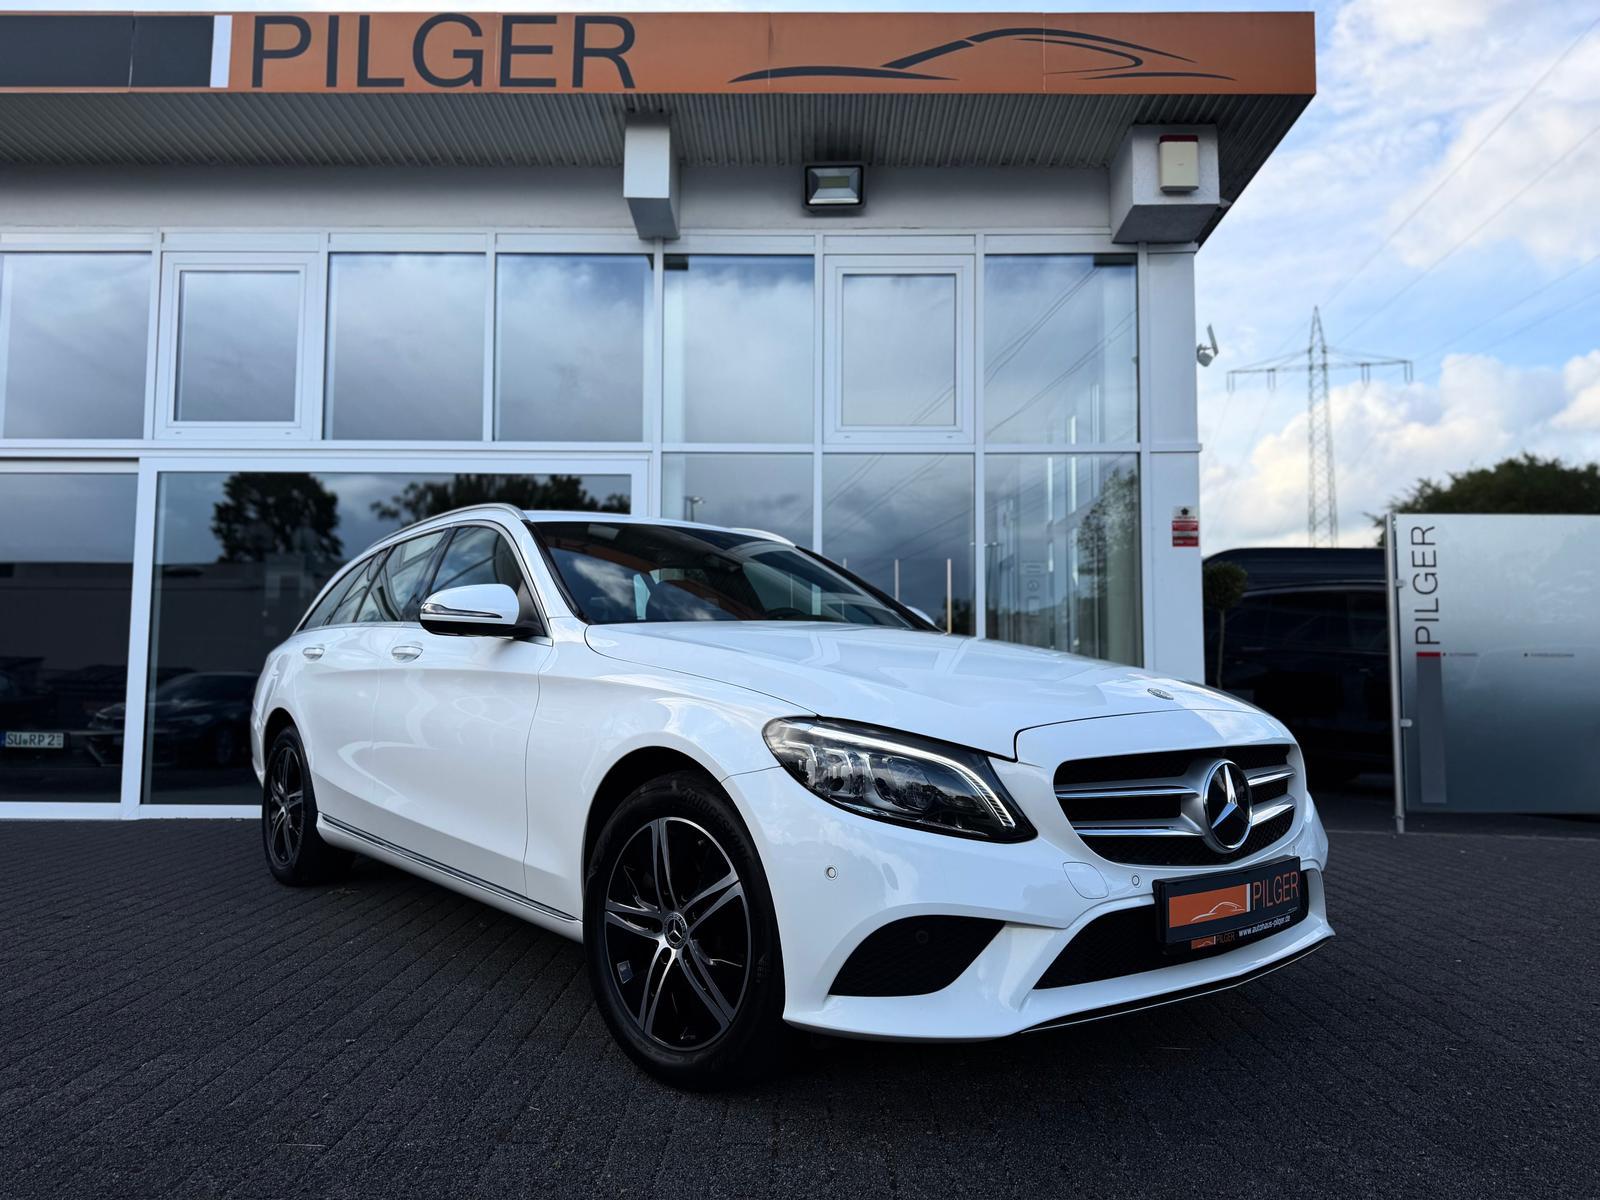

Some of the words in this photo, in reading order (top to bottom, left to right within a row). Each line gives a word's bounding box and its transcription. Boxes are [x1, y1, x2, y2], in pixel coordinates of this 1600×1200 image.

[251, 13, 636, 88] PILGER
[1410, 526, 1440, 645] PILGER
[1253, 871, 1299, 911] PILGER
[1239, 915, 1291, 937] www.autohaus-pilger.de
